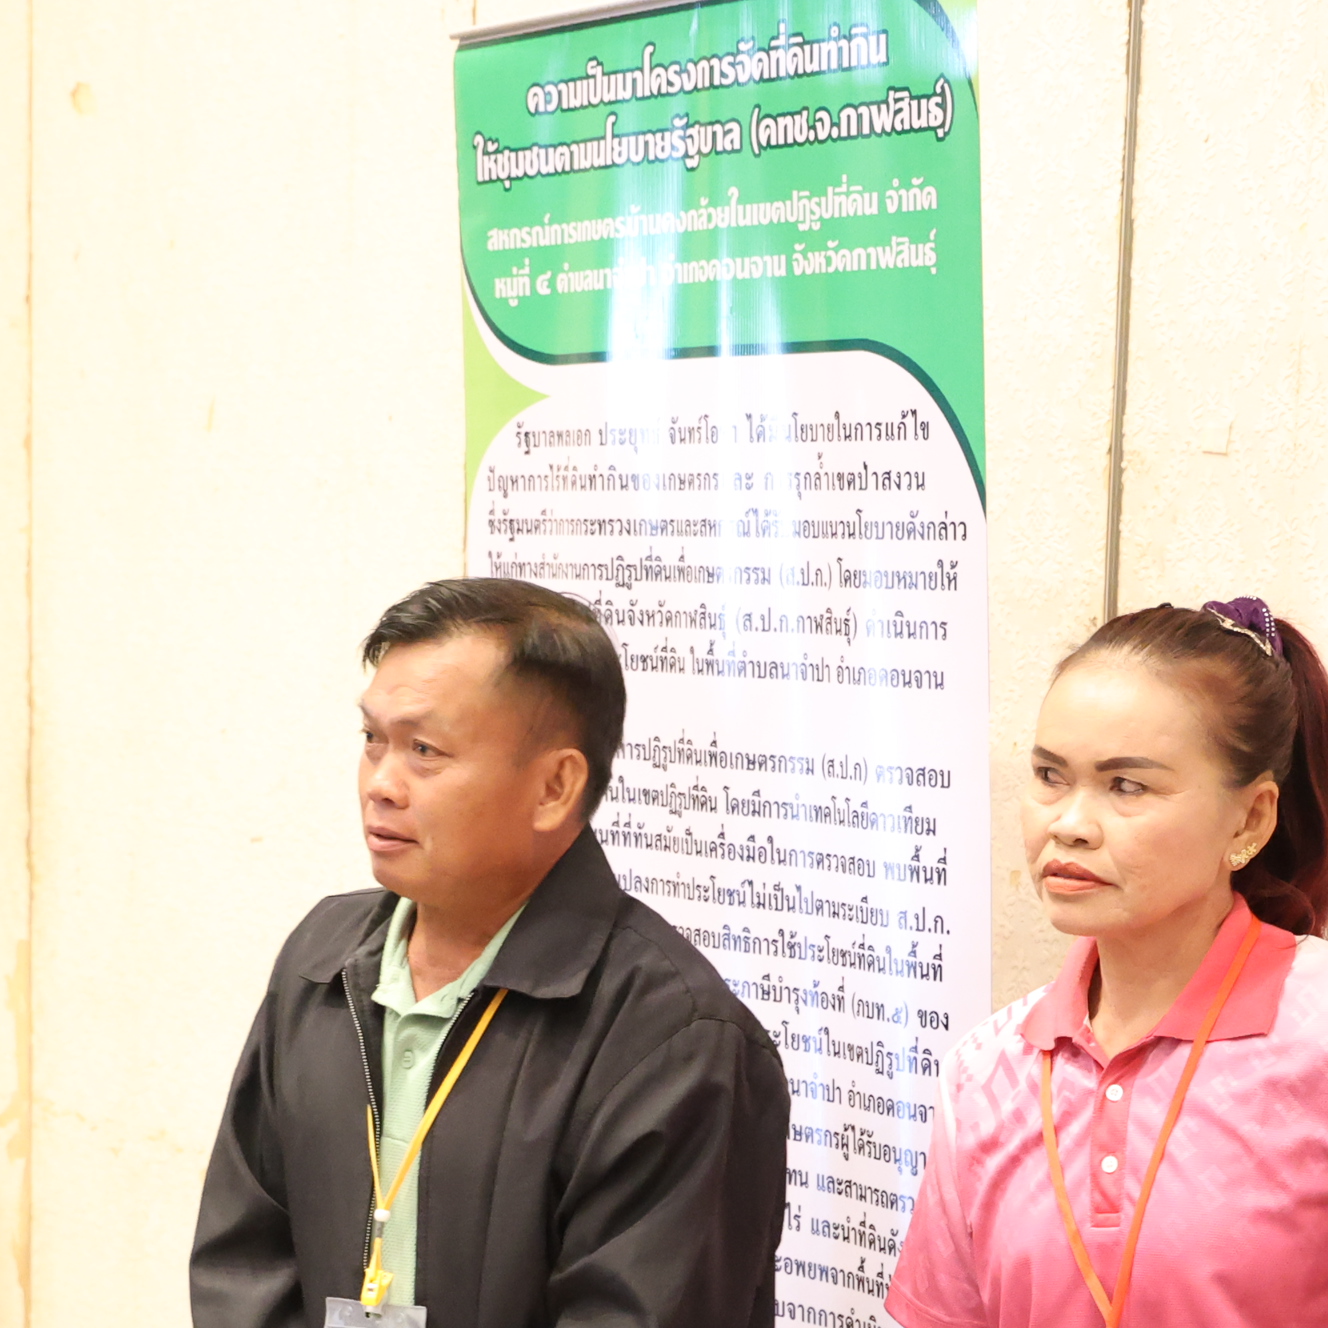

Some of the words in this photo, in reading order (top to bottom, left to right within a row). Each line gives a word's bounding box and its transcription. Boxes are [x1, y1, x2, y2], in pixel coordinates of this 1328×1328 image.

[527, 21, 888, 114] ความเป็นมาโครงการจัดที่ดินทำกิน
[473, 114, 742, 190] ให้ชุมชนตามนโยบายรัฐบาล
[885, 176, 938, 214] จำกัด
[493, 257, 531, 307] หมู่ที่
[536, 270, 552, 296] ๔
[515, 421, 592, 456] รัฐบาลพลเอก
[668, 412, 738, 446] จันทร์โอา
[835, 557, 959, 592] โดยมอบหมายให้
[836, 655, 945, 691] อำเภอดอนจาน
[875, 763, 952, 790] ตรวจสอบ
[883, 844, 948, 887] พบพื้นที่
[896, 905, 951, 936] ส.ป.ก.
[917, 1007, 950, 1032] ของ
